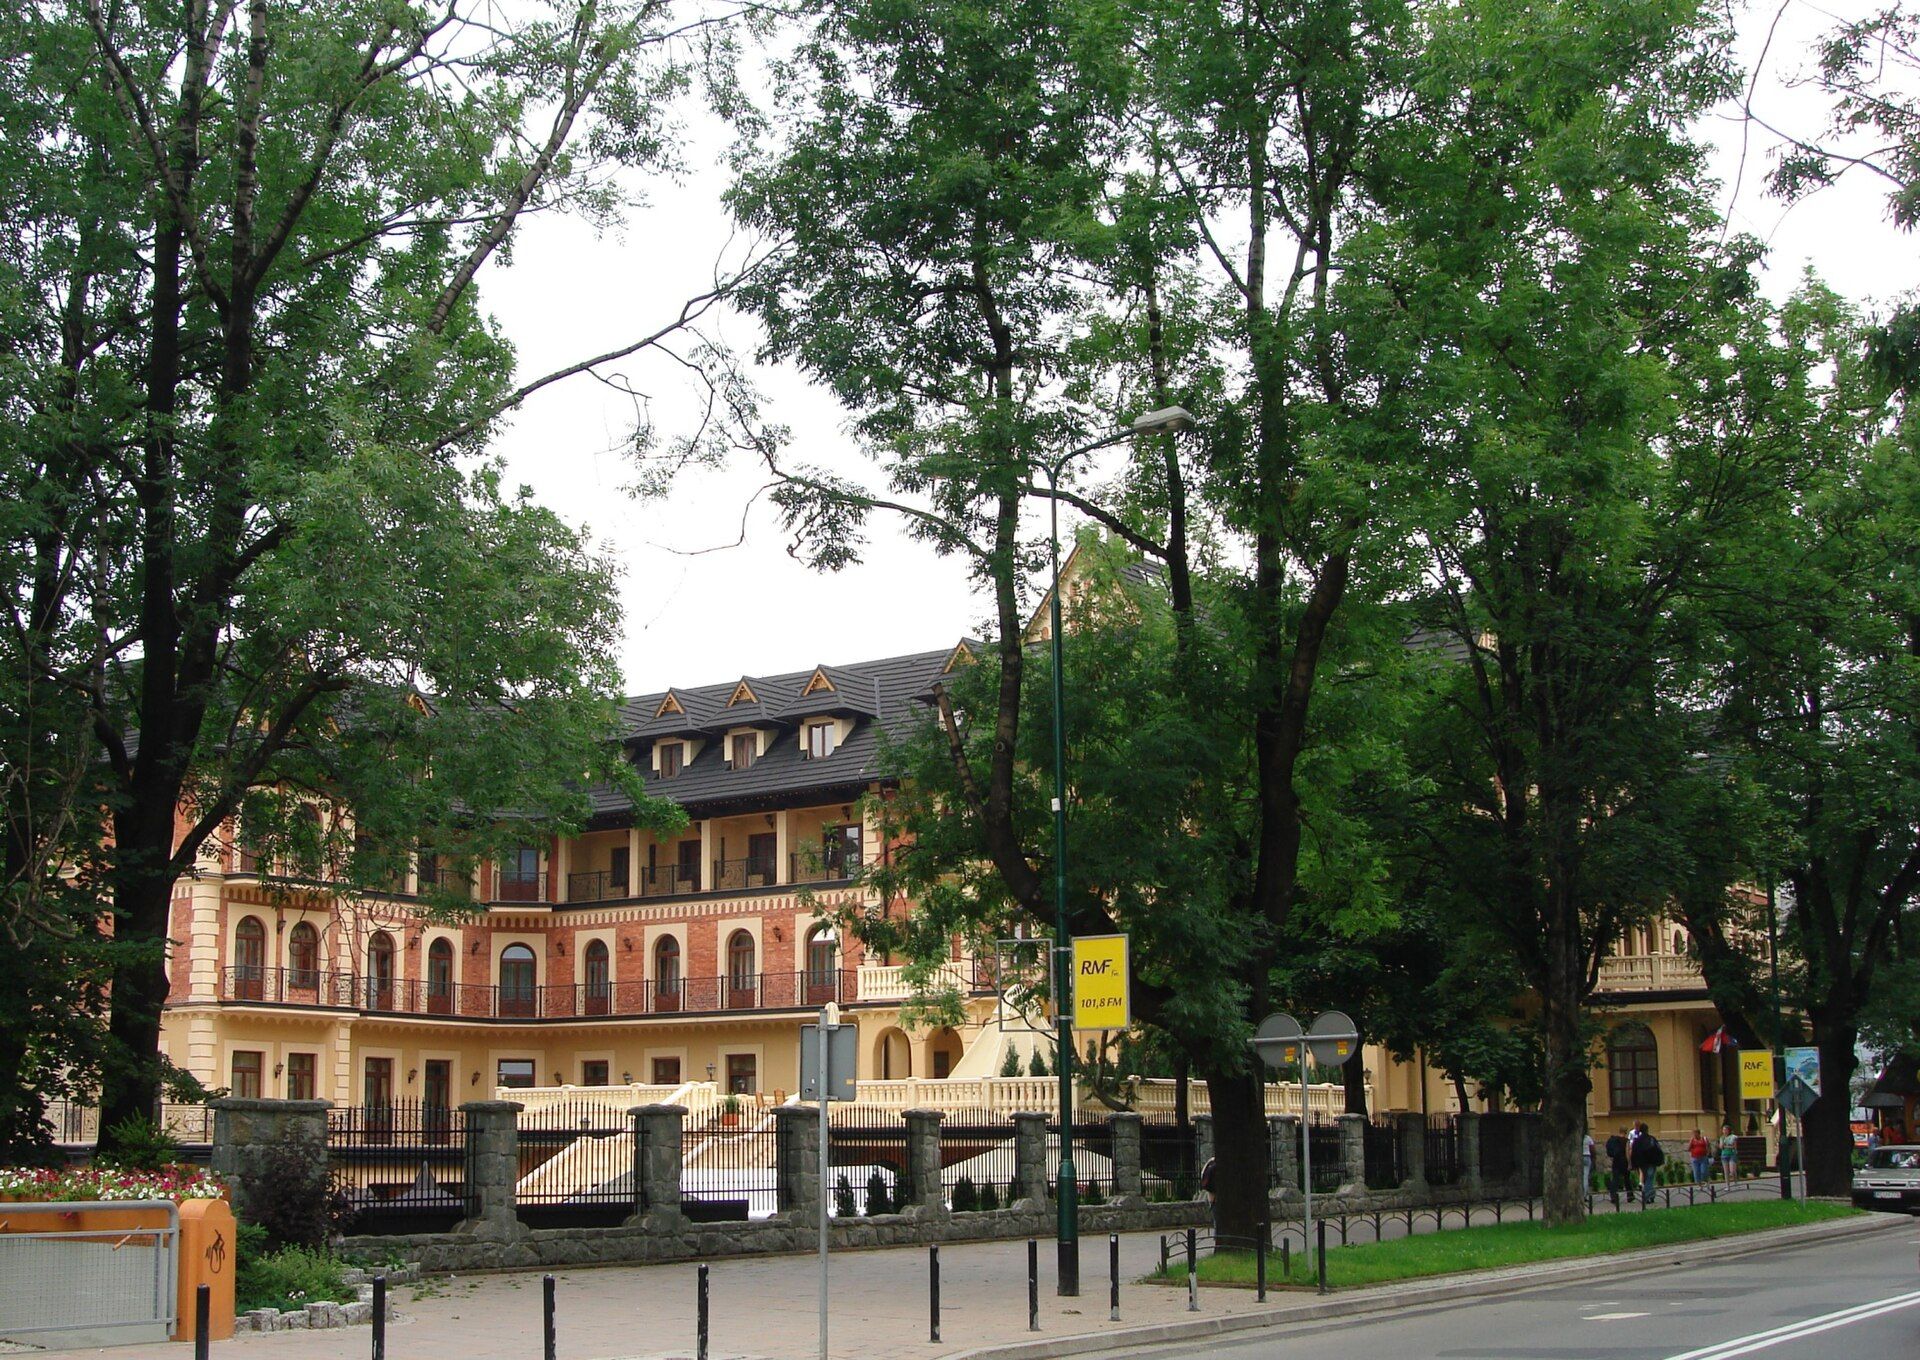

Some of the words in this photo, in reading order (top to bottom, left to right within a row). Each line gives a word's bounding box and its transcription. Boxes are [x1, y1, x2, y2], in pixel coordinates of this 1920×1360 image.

[1081, 959, 1113, 975] RMF
[1081, 998, 1105, 1009] 101,8
[1107, 997, 1122, 1006] FM
[1744, 1061, 1764, 1070] RMF
